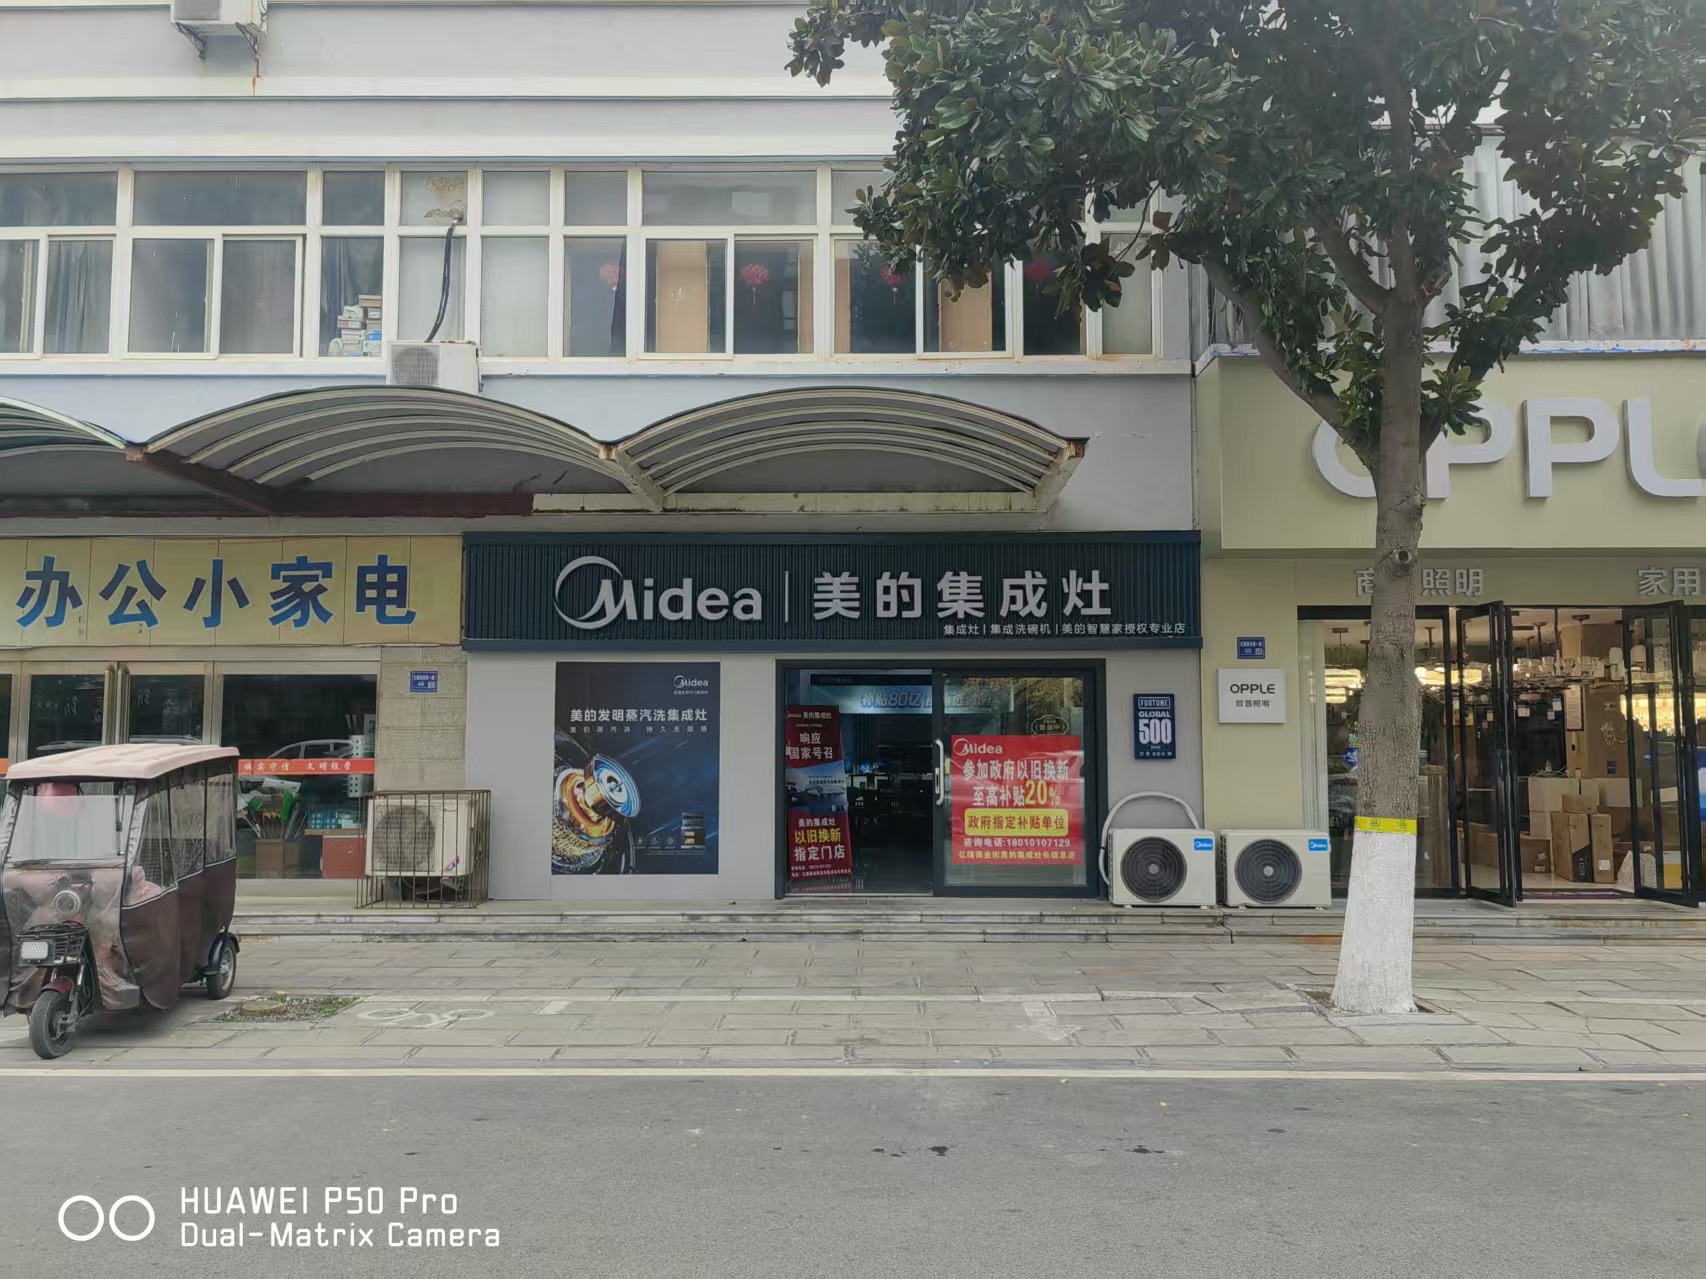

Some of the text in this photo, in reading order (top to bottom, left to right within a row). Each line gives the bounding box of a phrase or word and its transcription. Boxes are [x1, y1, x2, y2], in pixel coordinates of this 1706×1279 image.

[1312, 397, 1706, 499] PPL
[1355, 566, 1484, 597] 商照明
[1637, 566, 1700, 597] 家用
[15, 554, 417, 629] 办公小家电
[553, 555, 1112, 630] Midea 美的集成灶
[943, 622, 1186, 635] 集成灶 集成洗碗机 美的智慧家授权专业店
[673, 675, 709, 689] Midea
[1229, 683, 1276, 695] OPPLE
[1140, 698, 1169, 707] FORTUNE
[1235, 699, 1270, 708] 欧普照明
[570, 708, 708, 722] 美的发明蒸汽洗集成灶
[1138, 710, 1171, 718] GLOBAL
[799, 732, 822, 745] 响应
[1138, 718, 1173, 745] 500
[789, 746, 833, 760] 国家号召
[953, 738, 1003, 756] Midea
[962, 759, 1070, 781] 参加政府以旧换新
[972, 779, 1061, 807] 至高补贴20%
[798, 817, 836, 828] 美的集成灶
[967, 815, 1066, 830] 政府指定补贴单位
[794, 828, 841, 844] 以旧换新
[793, 844, 846, 862] 指定门店
